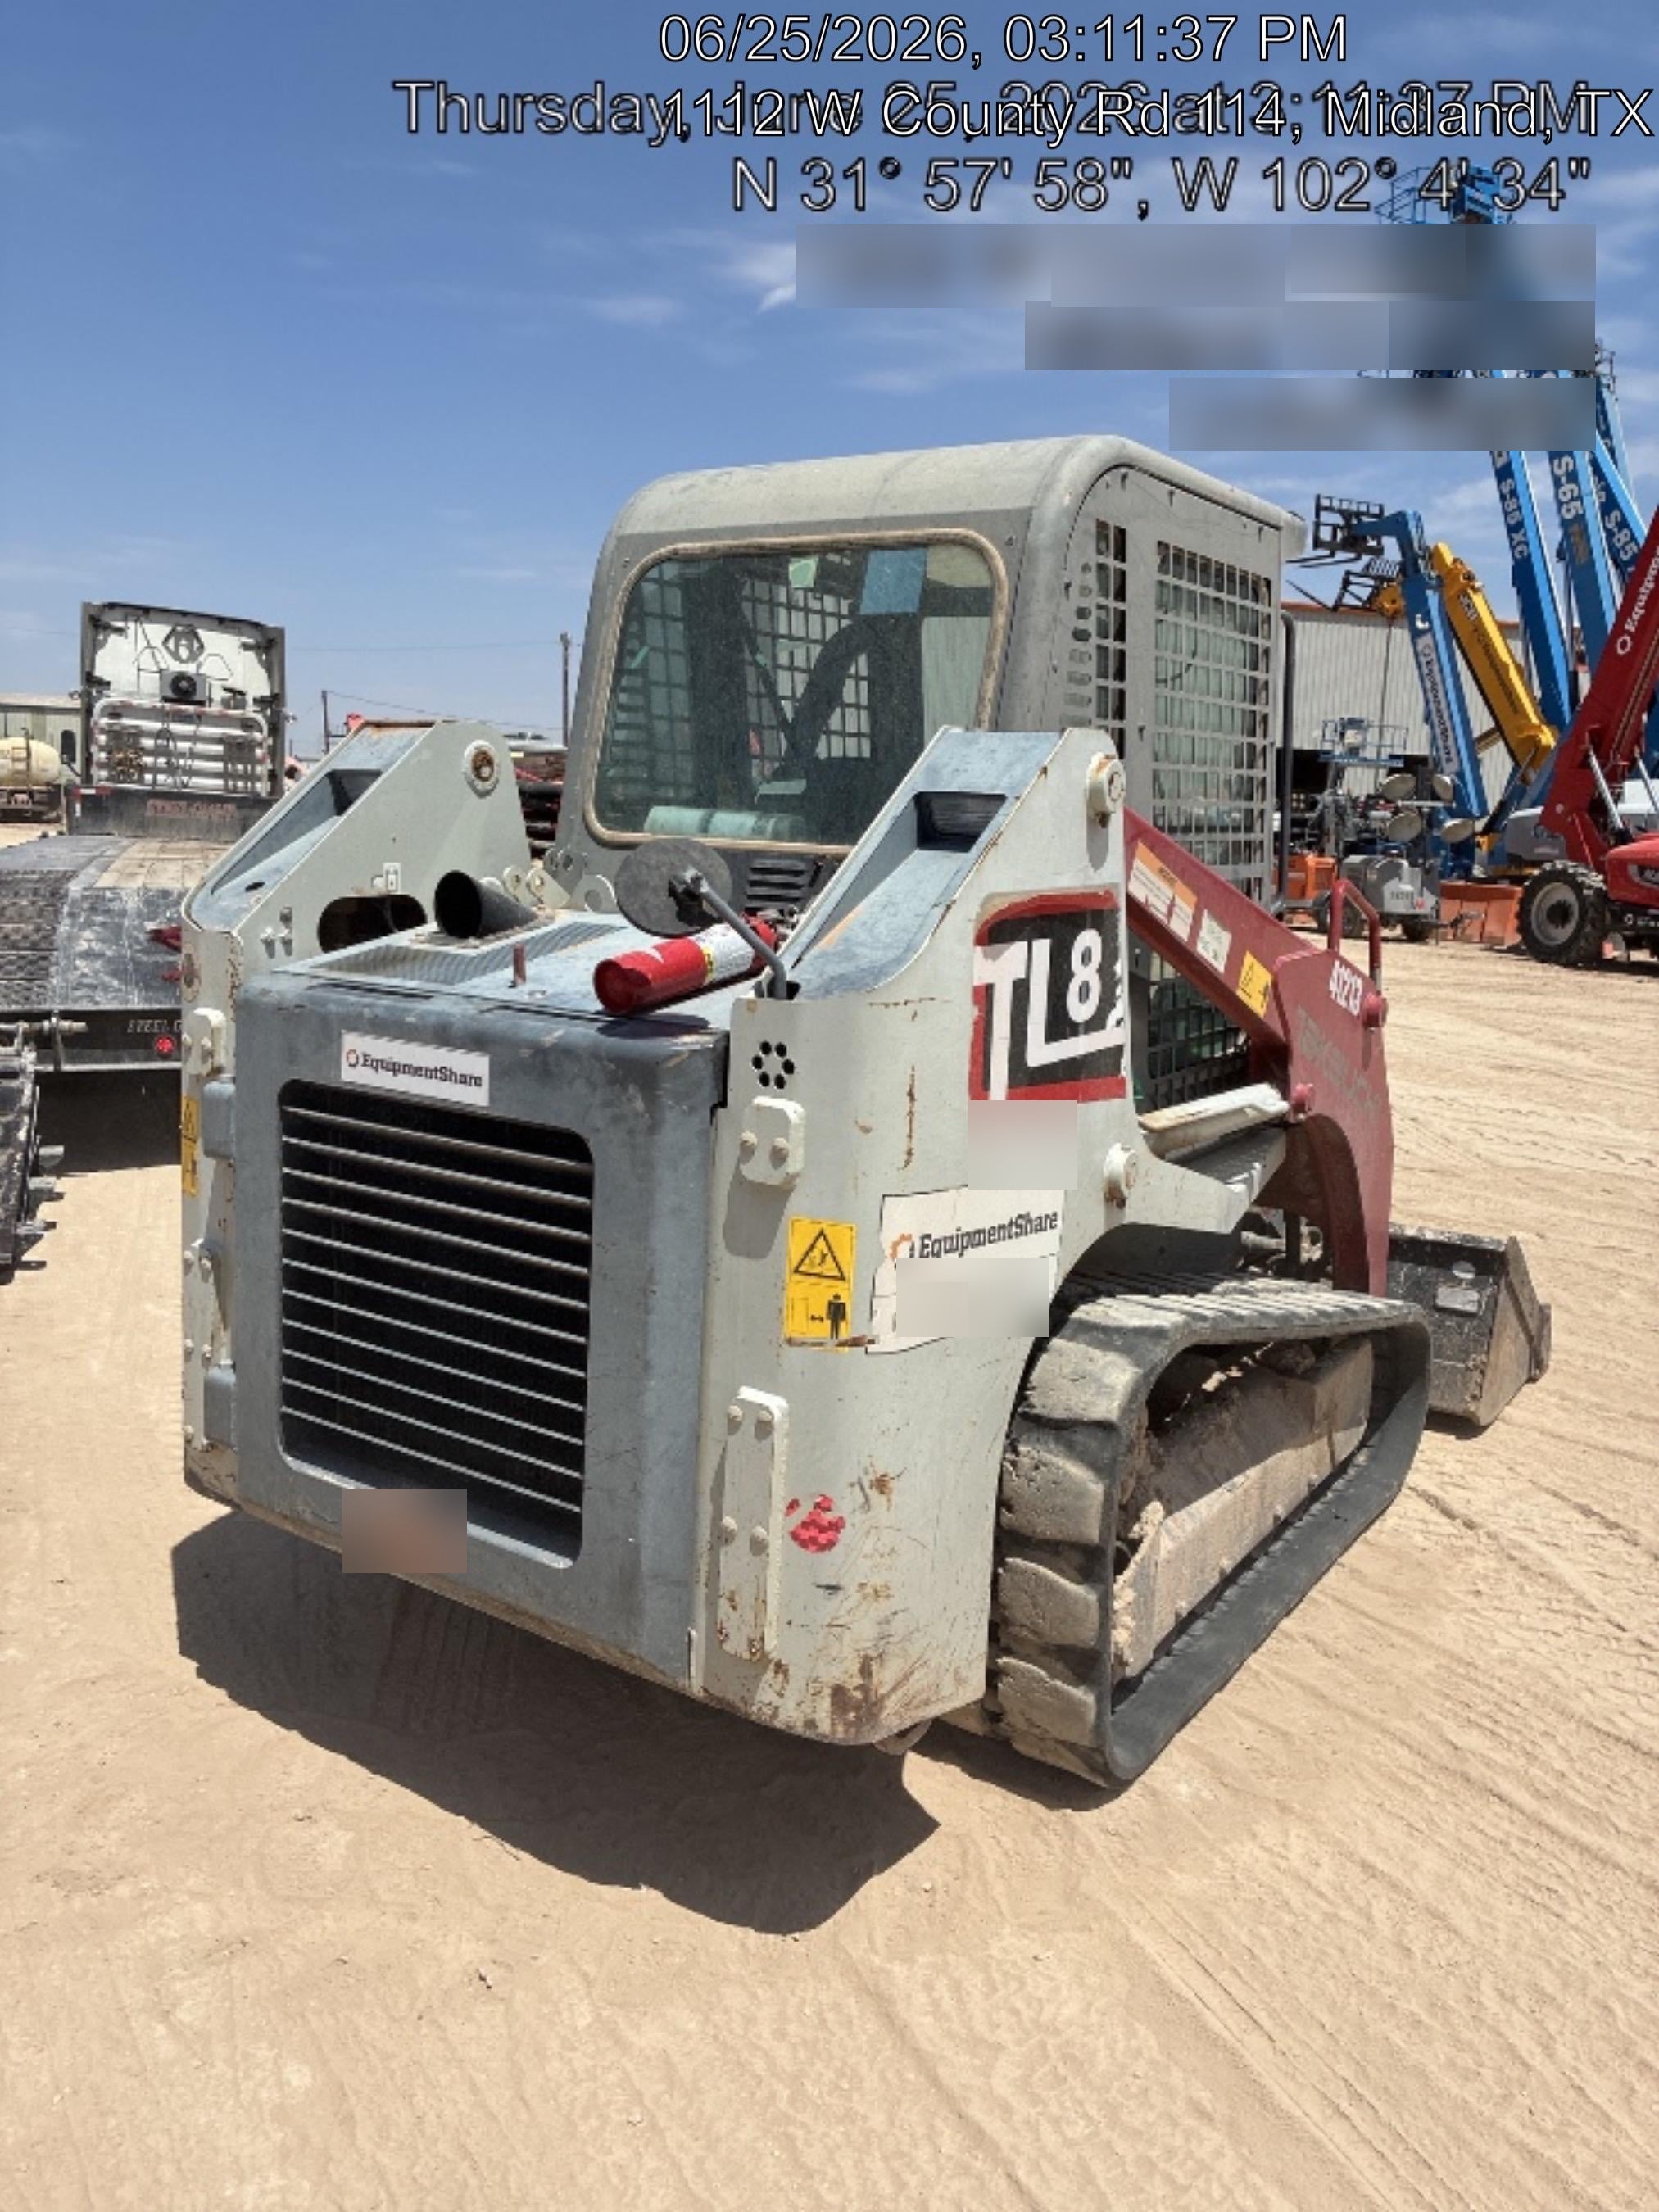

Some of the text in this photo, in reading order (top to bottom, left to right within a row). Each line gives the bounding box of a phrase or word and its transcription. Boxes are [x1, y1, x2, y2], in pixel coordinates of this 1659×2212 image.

[1552, 455, 1584, 520] S-65
[1604, 509, 1639, 560] S-85
[361, 1053, 483, 1088] EquipmentShare
[918, 1211, 1058, 1259] EquipmentShare
